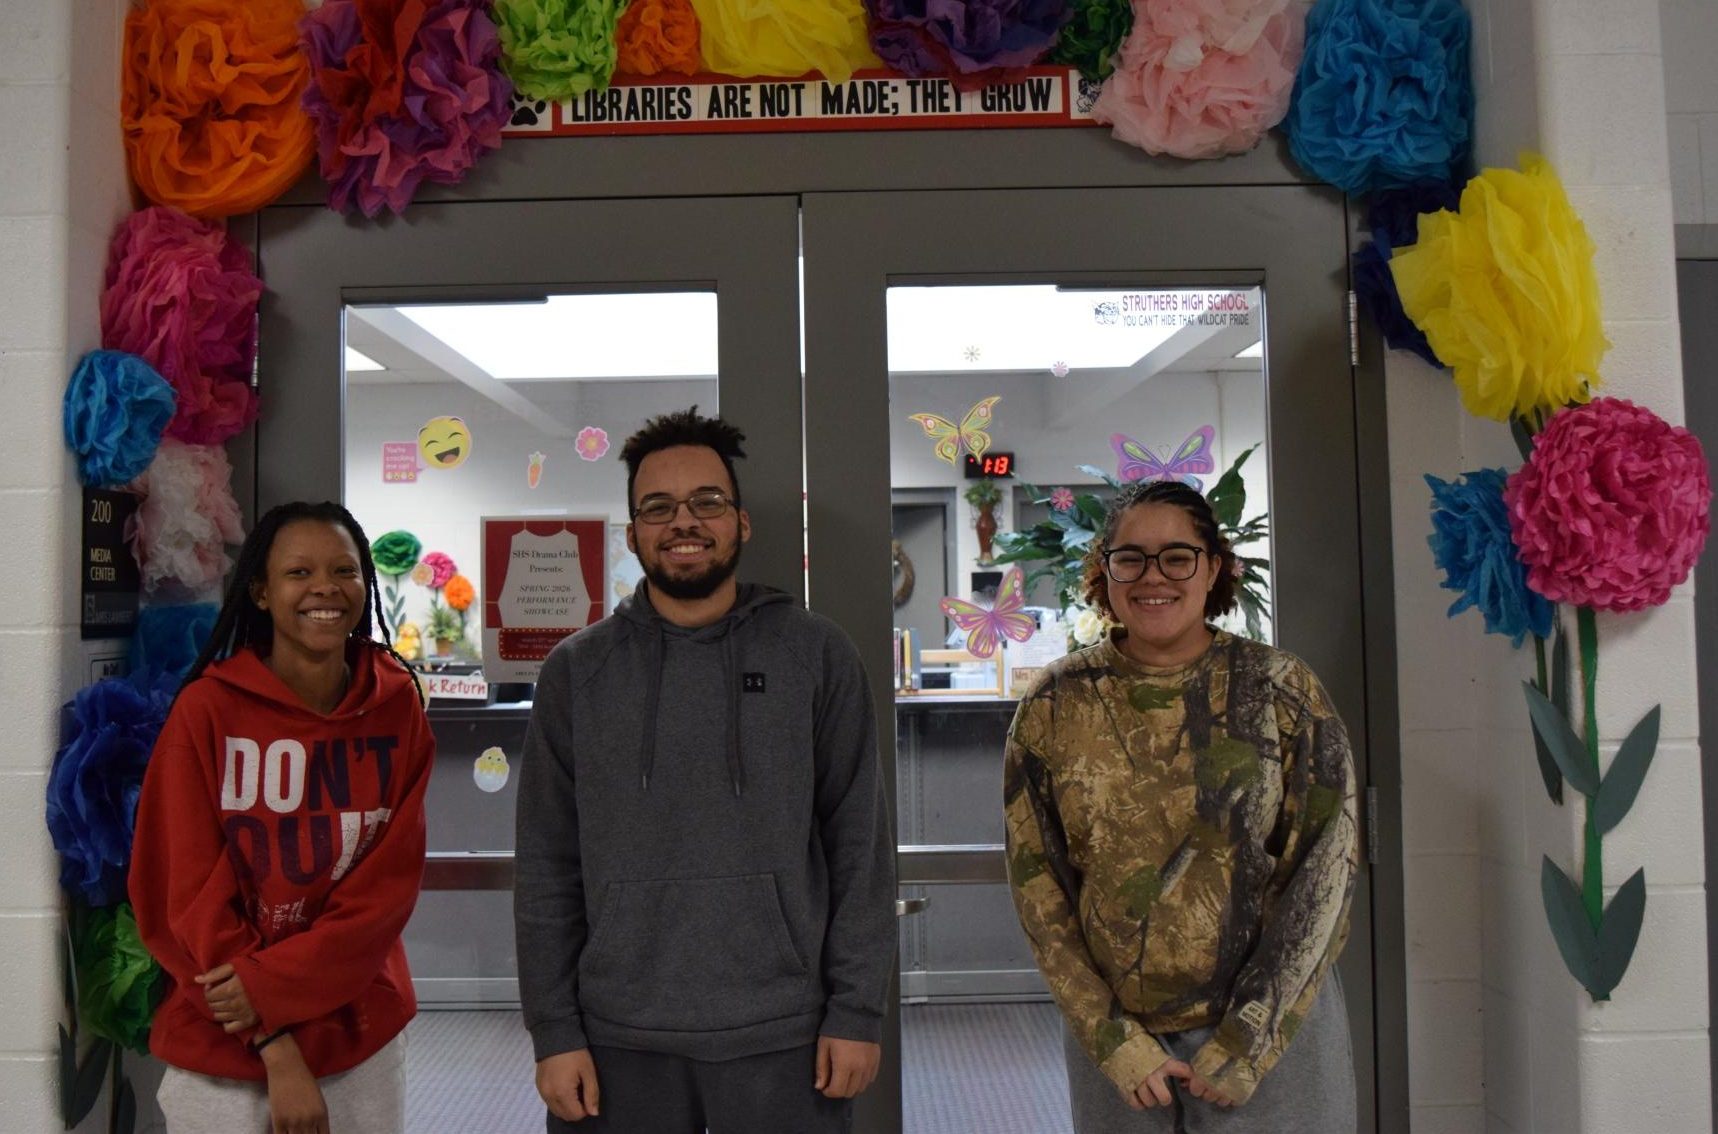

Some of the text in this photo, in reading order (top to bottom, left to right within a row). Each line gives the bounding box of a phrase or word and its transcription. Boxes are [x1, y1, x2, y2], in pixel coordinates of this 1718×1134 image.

[572, 78, 1053, 122] LIBRARIES ARE NOT MADE; THEY GROW
[1122, 293, 1249, 311] STRUTHERS HIGH SCHOOL
[1122, 313, 1249, 326] YOU CAN'T HIDE THAT WILDCAT PRIDE
[91, 500, 112, 523] 200
[90, 548, 112, 563] MEDIA
[512, 550, 579, 559] SHS Drama Club
[90, 567, 116, 582] CENTER
[519, 585, 550, 593] SPRING
[516, 596, 577, 604] PERFORMANCE
[441, 680, 485, 694] Return
[220, 735, 399, 814] DON'T
[223, 807, 392, 888] QUIT
